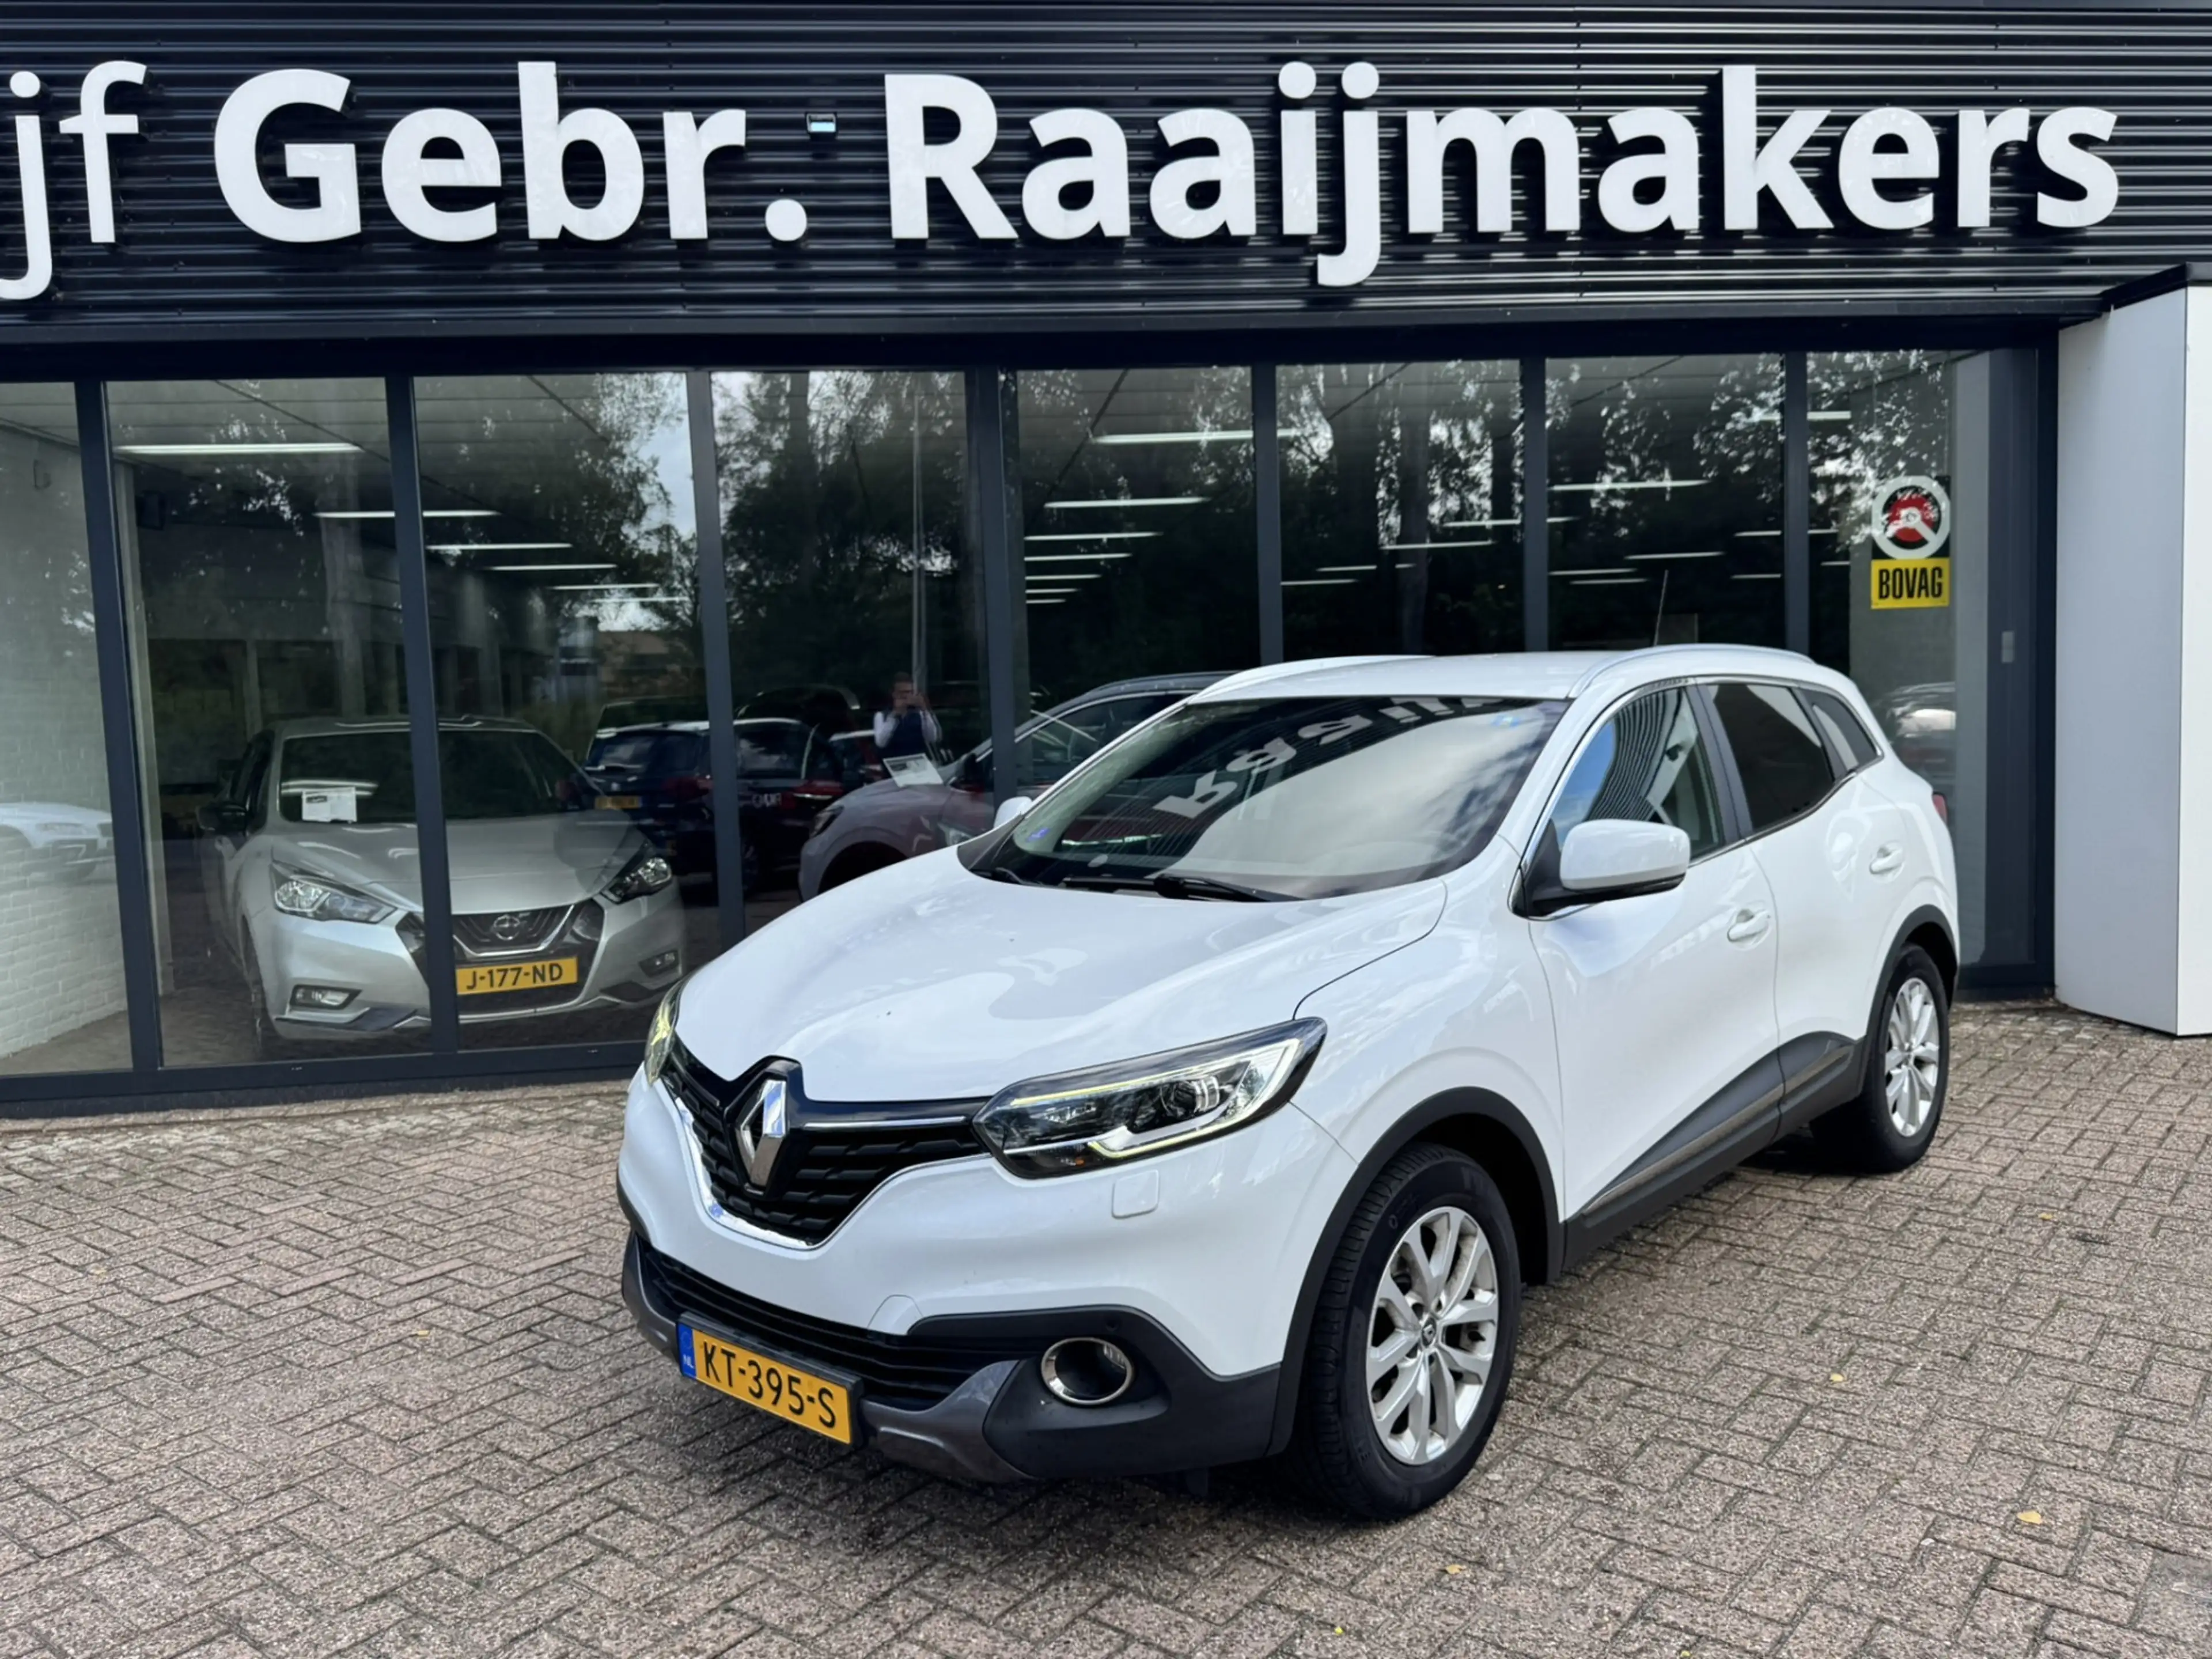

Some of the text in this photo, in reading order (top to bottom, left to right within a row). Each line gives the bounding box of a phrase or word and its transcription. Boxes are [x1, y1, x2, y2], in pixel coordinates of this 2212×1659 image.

[214, 60, 808, 243] Gebr.
[885, 62, 2120, 287] Raaijmakers
[1878, 566, 1943, 599] BOVAG
[467, 962, 563, 990] J-177-ND
[703, 1341, 836, 1429] KT-395-S
